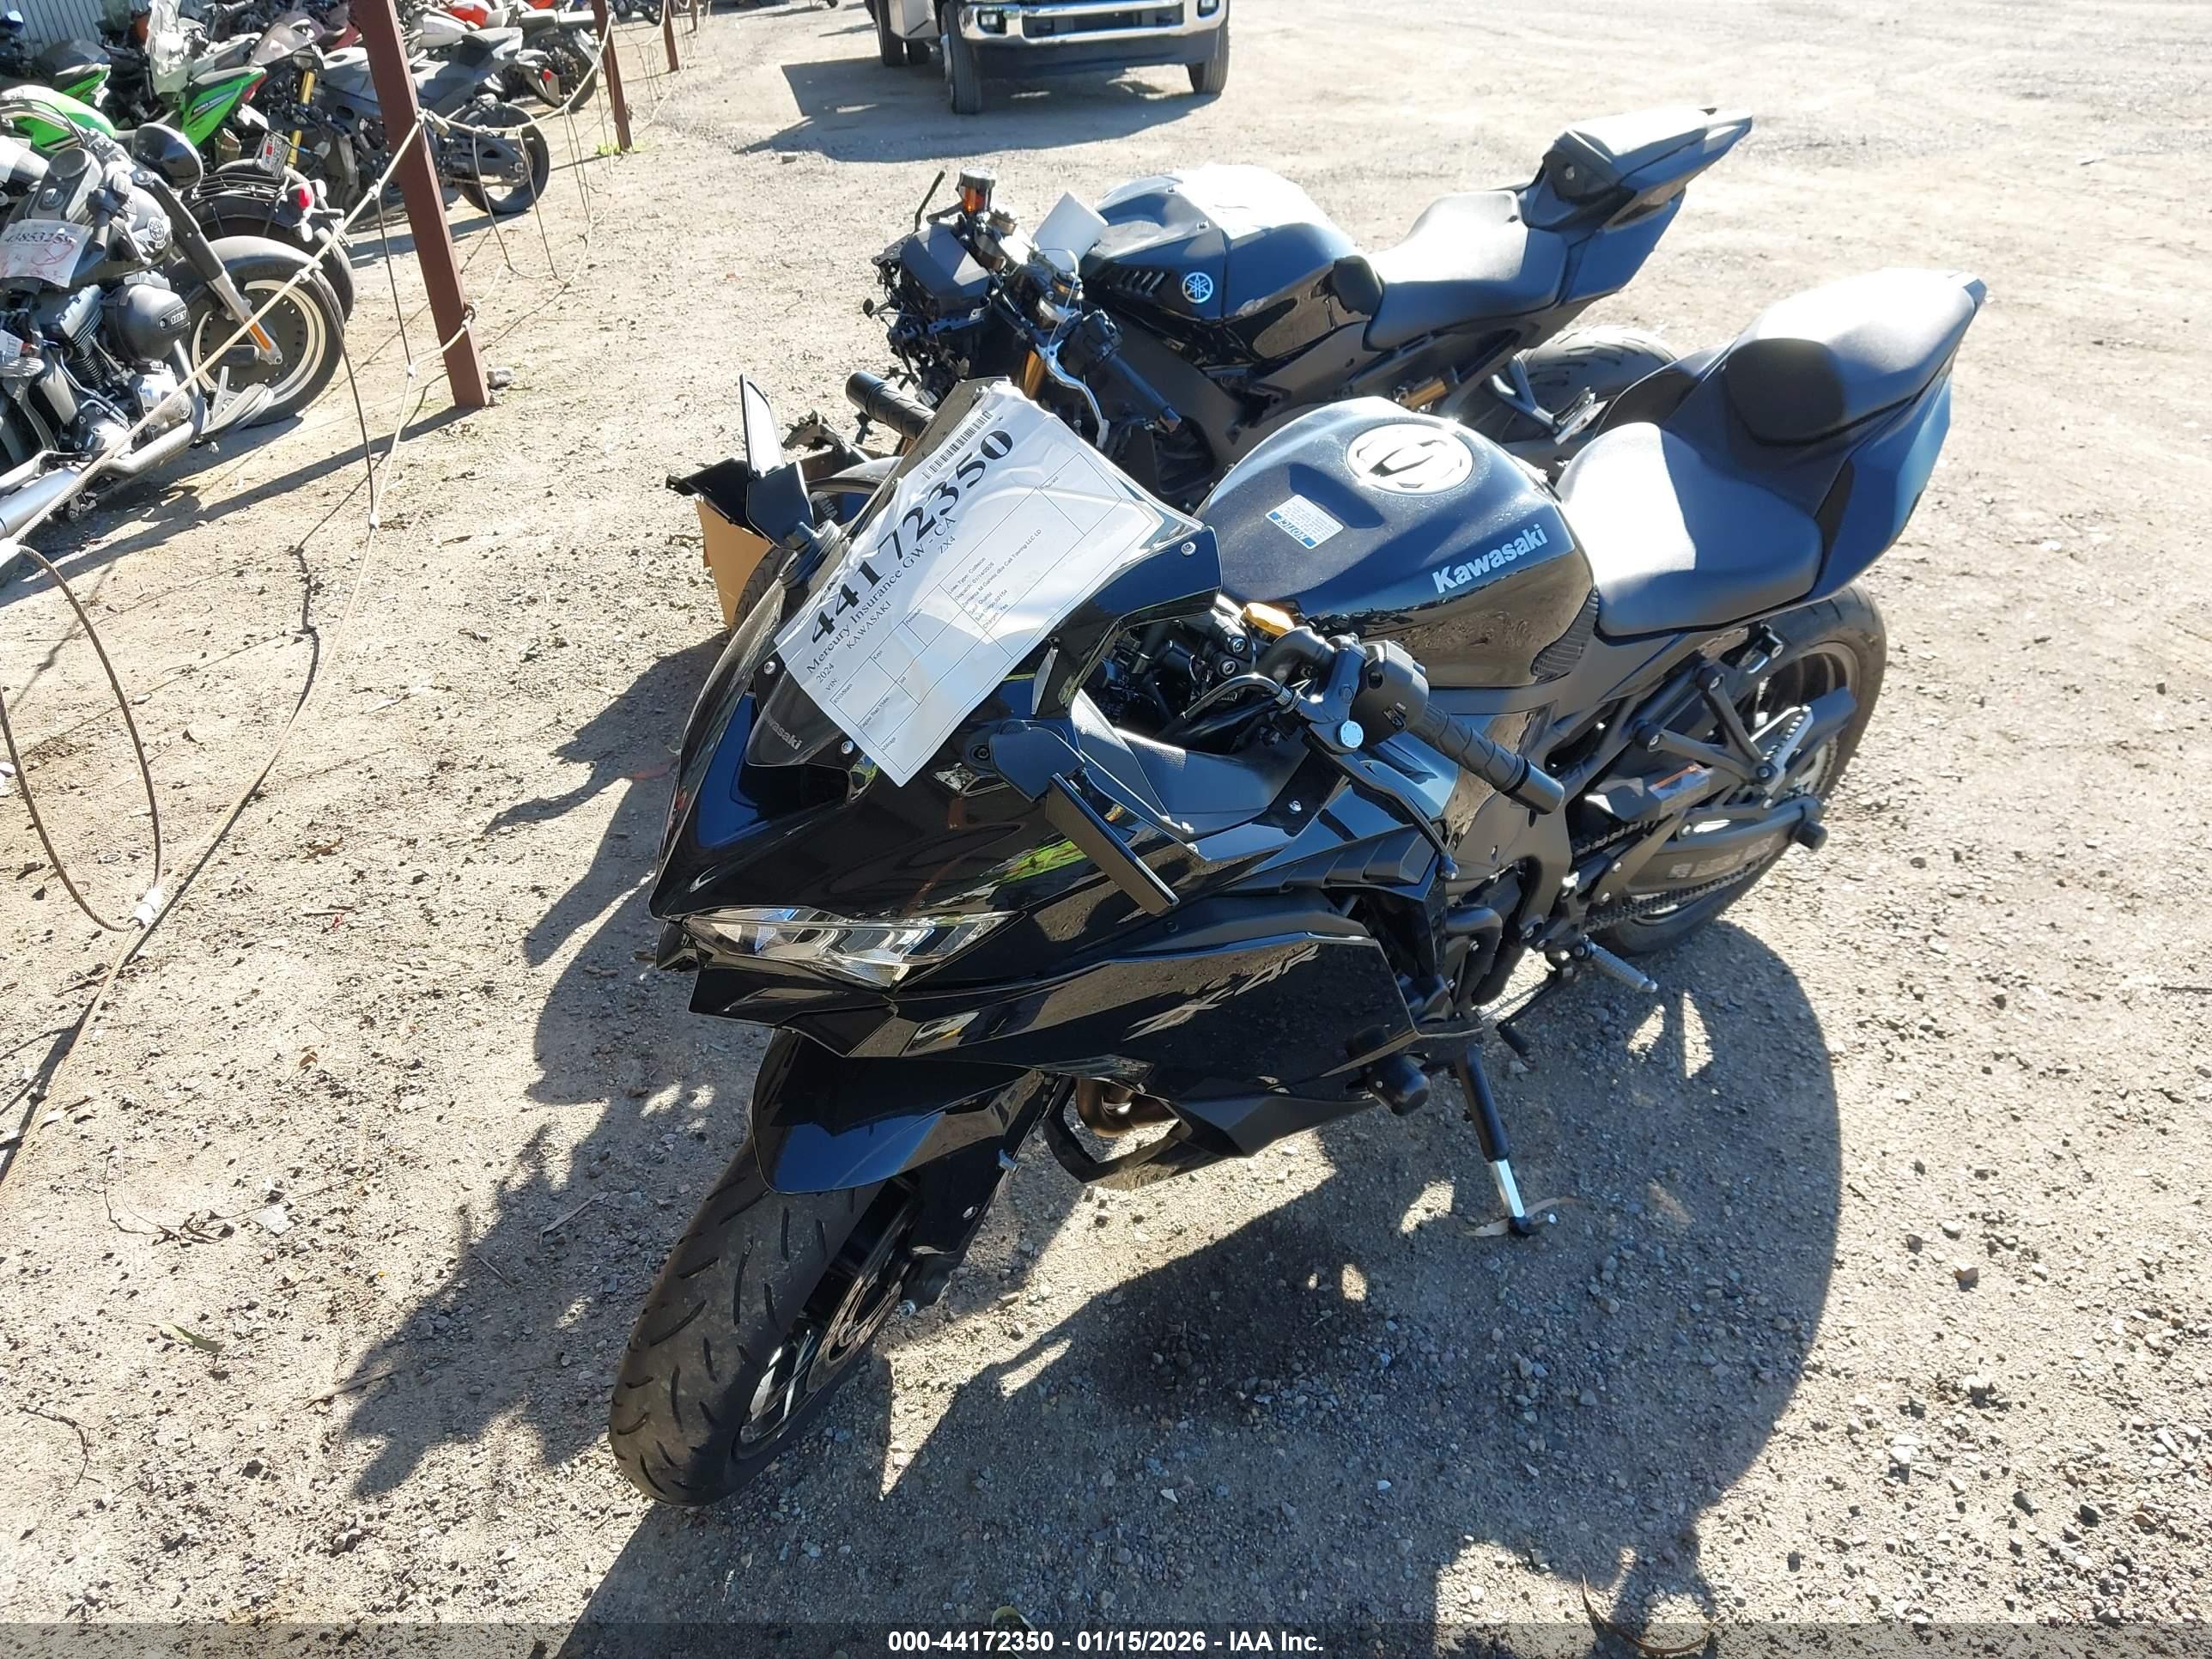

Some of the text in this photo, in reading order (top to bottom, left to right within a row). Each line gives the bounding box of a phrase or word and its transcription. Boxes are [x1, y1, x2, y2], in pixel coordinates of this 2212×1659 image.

[812, 430, 1013, 644] 44172350
[1024, 534, 1036, 545] LLC
[1274, 515, 1307, 540] NOTICE
[1432, 523, 1548, 594] Kawasaki
[807, 624, 850, 673] Mercury
[849, 568, 903, 623] Insurance
[902, 544, 926, 568] GW
[934, 516, 957, 536] CA
[817, 535, 957, 683] 2024 KAWASAKI ZX4
[825, 677, 840, 691] VIN:
[858, 714, 873, 729] Engine
